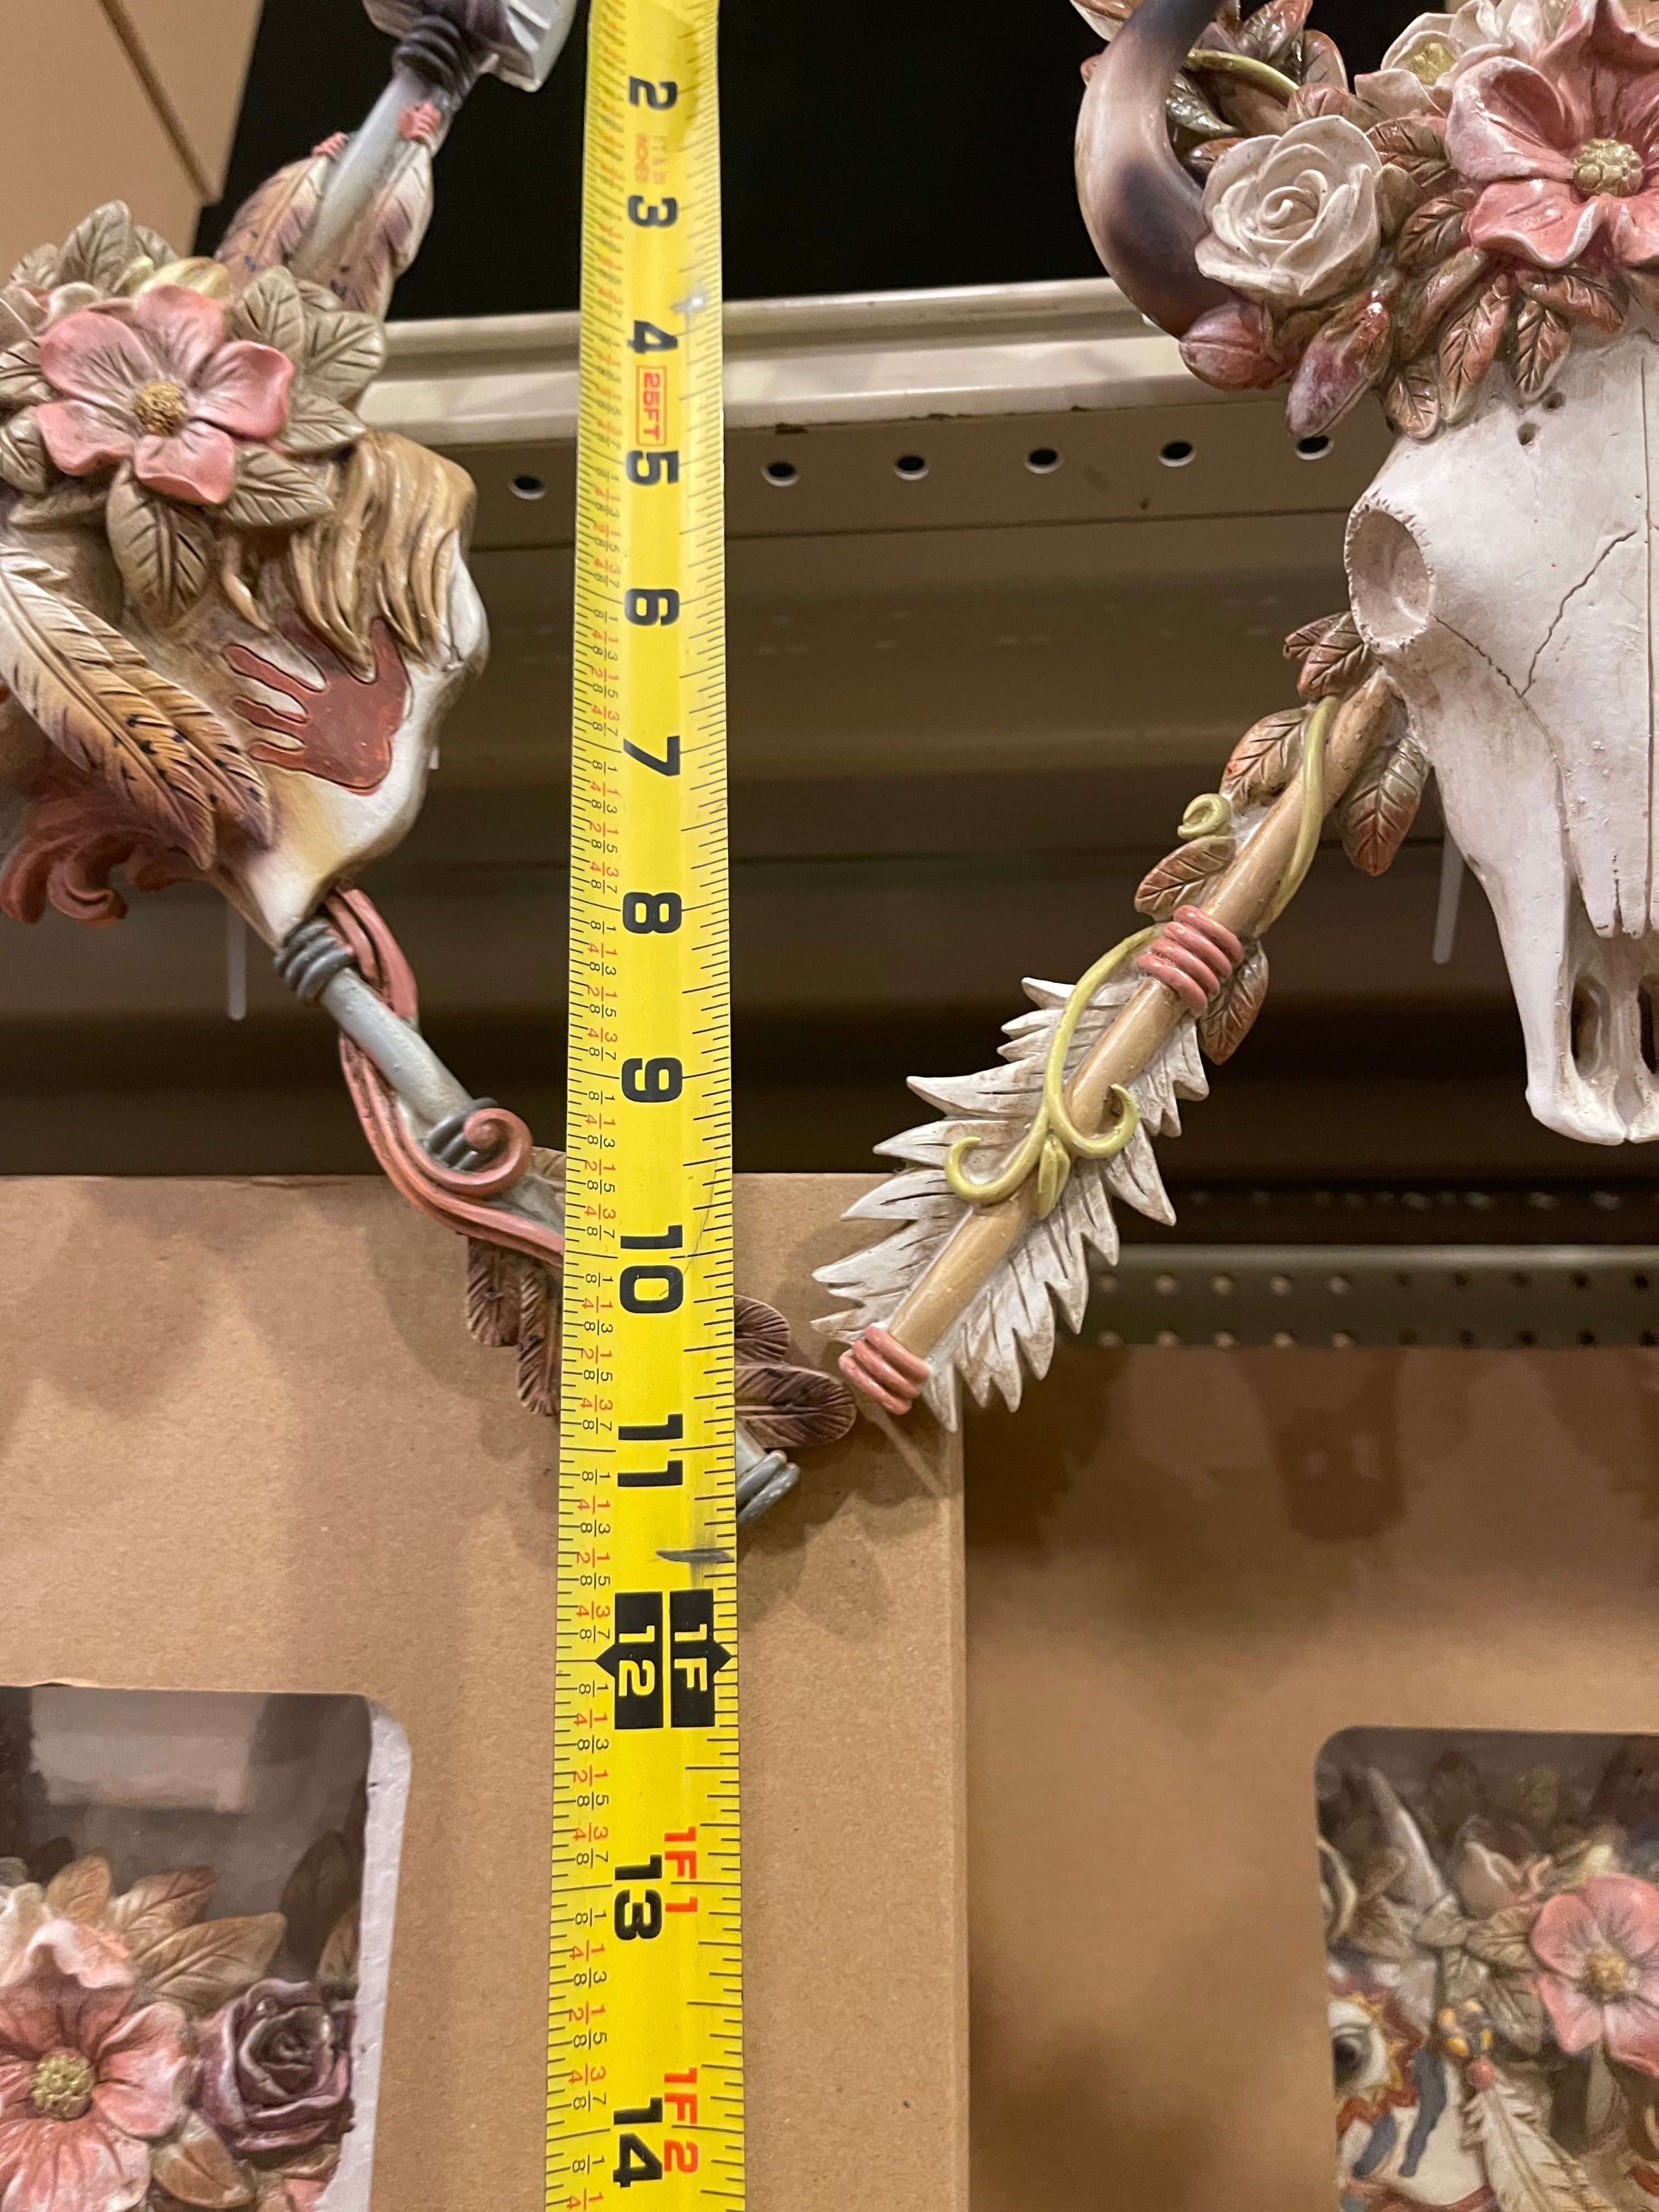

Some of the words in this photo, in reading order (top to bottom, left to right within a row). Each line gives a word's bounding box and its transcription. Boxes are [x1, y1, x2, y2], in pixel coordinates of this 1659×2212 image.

[628, 76, 678, 110] 2
[628, 194, 678, 228] 3
[625, 320, 679, 354] 4
[643, 373, 661, 441] 25FT
[625, 450, 679, 487] 5
[624, 588, 680, 626] 6
[623, 735, 681, 776] 7
[622, 892, 682, 934] 8
[622, 1058, 682, 1103] 9
[619, 1224, 684, 1314] 10
[617, 1414, 684, 1487] 11
[618, 1626, 655, 1697] 12
[674, 1623, 708, 1691] 1F
[614, 1854, 662, 1940] 13
[612, 2096, 663, 2188] 14
